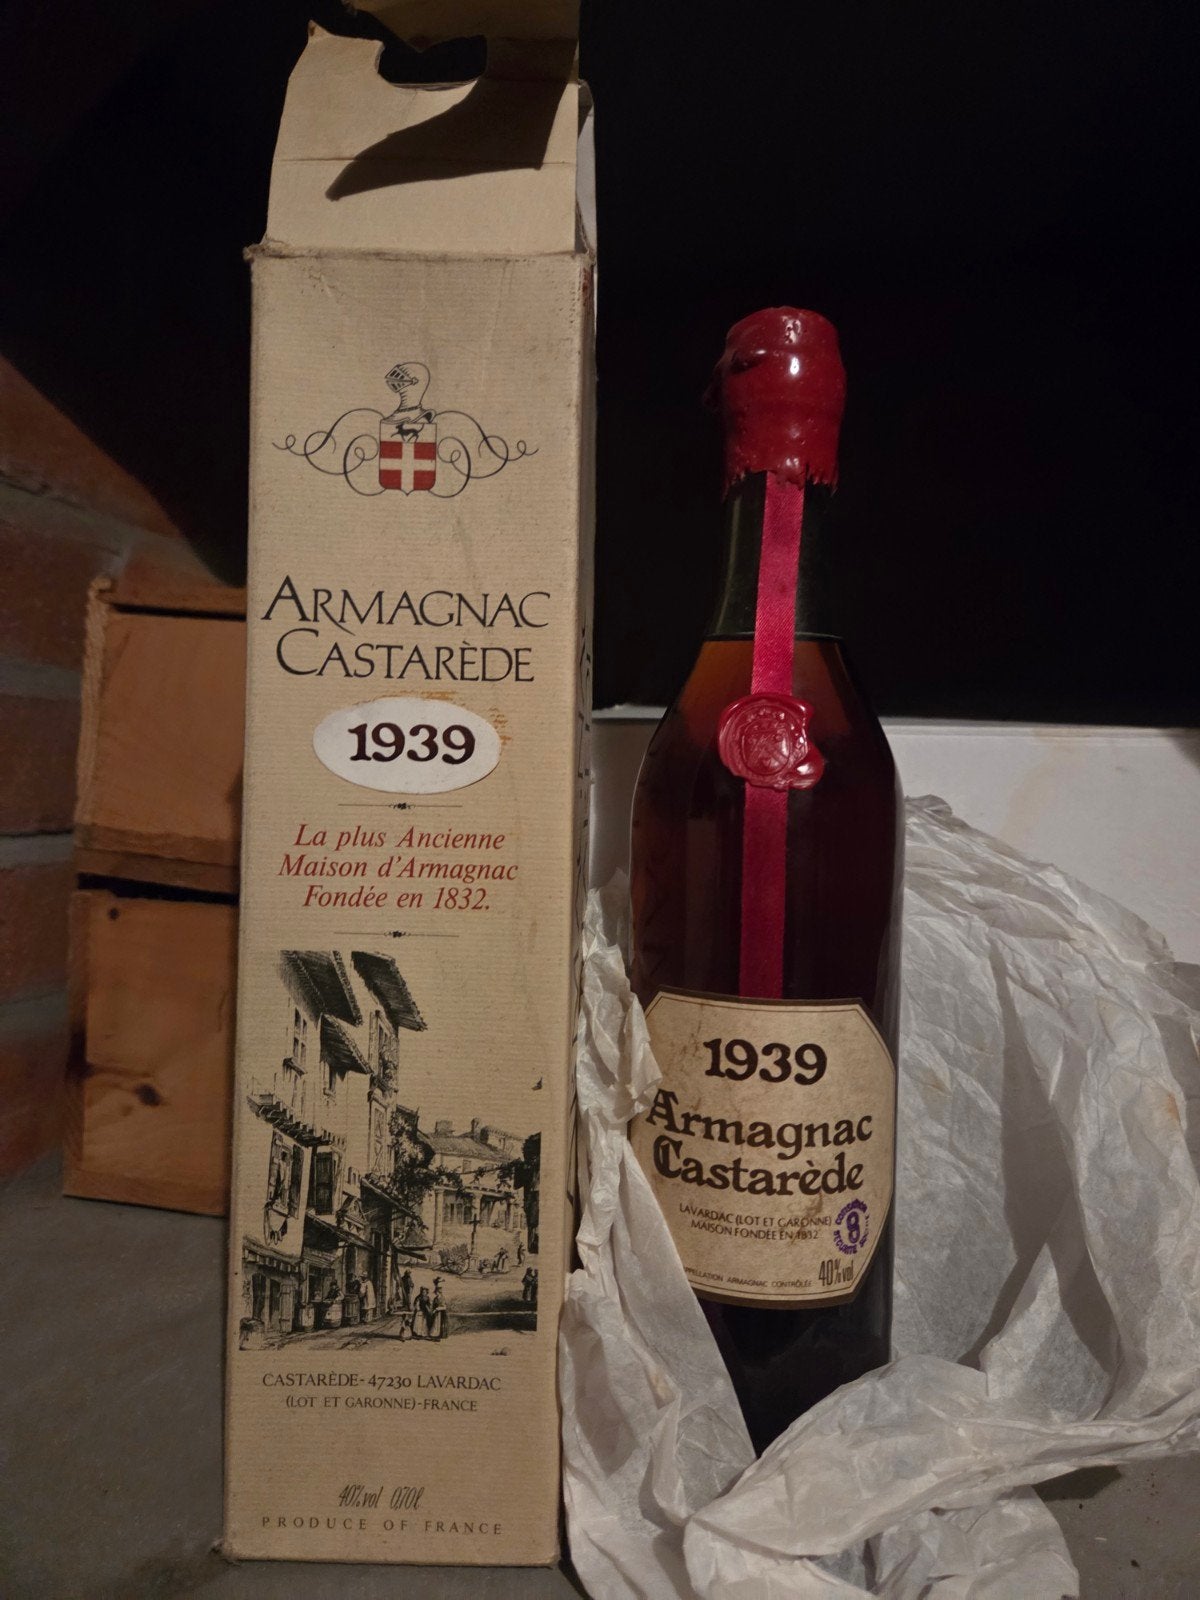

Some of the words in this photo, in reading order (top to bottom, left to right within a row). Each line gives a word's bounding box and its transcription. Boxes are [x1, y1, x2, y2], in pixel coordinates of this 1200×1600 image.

[261, 575, 551, 636] ARMAGNAC
[276, 628, 535, 682] CASTARÈDE
[348, 722, 476, 765] 1939
[294, 824, 327, 847] La
[335, 826, 387, 851] plus
[397, 827, 506, 850] Ancienne
[278, 854, 368, 877] Maison
[302, 885, 388, 908] Fondée
[396, 892, 423, 909] en
[433, 887, 491, 911] 1832.
[703, 1038, 828, 1086] 1939
[645, 1088, 873, 1160] Armagnac
[653, 1135, 864, 1196] Castarède
[679, 1203, 733, 1224] LAVARDAC
[735, 1216, 760, 1226] (LOT
[763, 1217, 774, 1227] ET
[690, 1219, 732, 1236] MAISON
[779, 1230, 793, 1240] EN
[684, 1267, 723, 1282] PPELLATION
[367, 1376, 412, 1388] 47230
[417, 1376, 502, 1391] LAVARDAC
[285, 1395, 317, 1408] (LOT
[323, 1396, 339, 1408] ET
[261, 1517, 368, 1530] PRODUCE
[383, 1519, 409, 1531] OF
[424, 1521, 503, 1535] FRANCE
